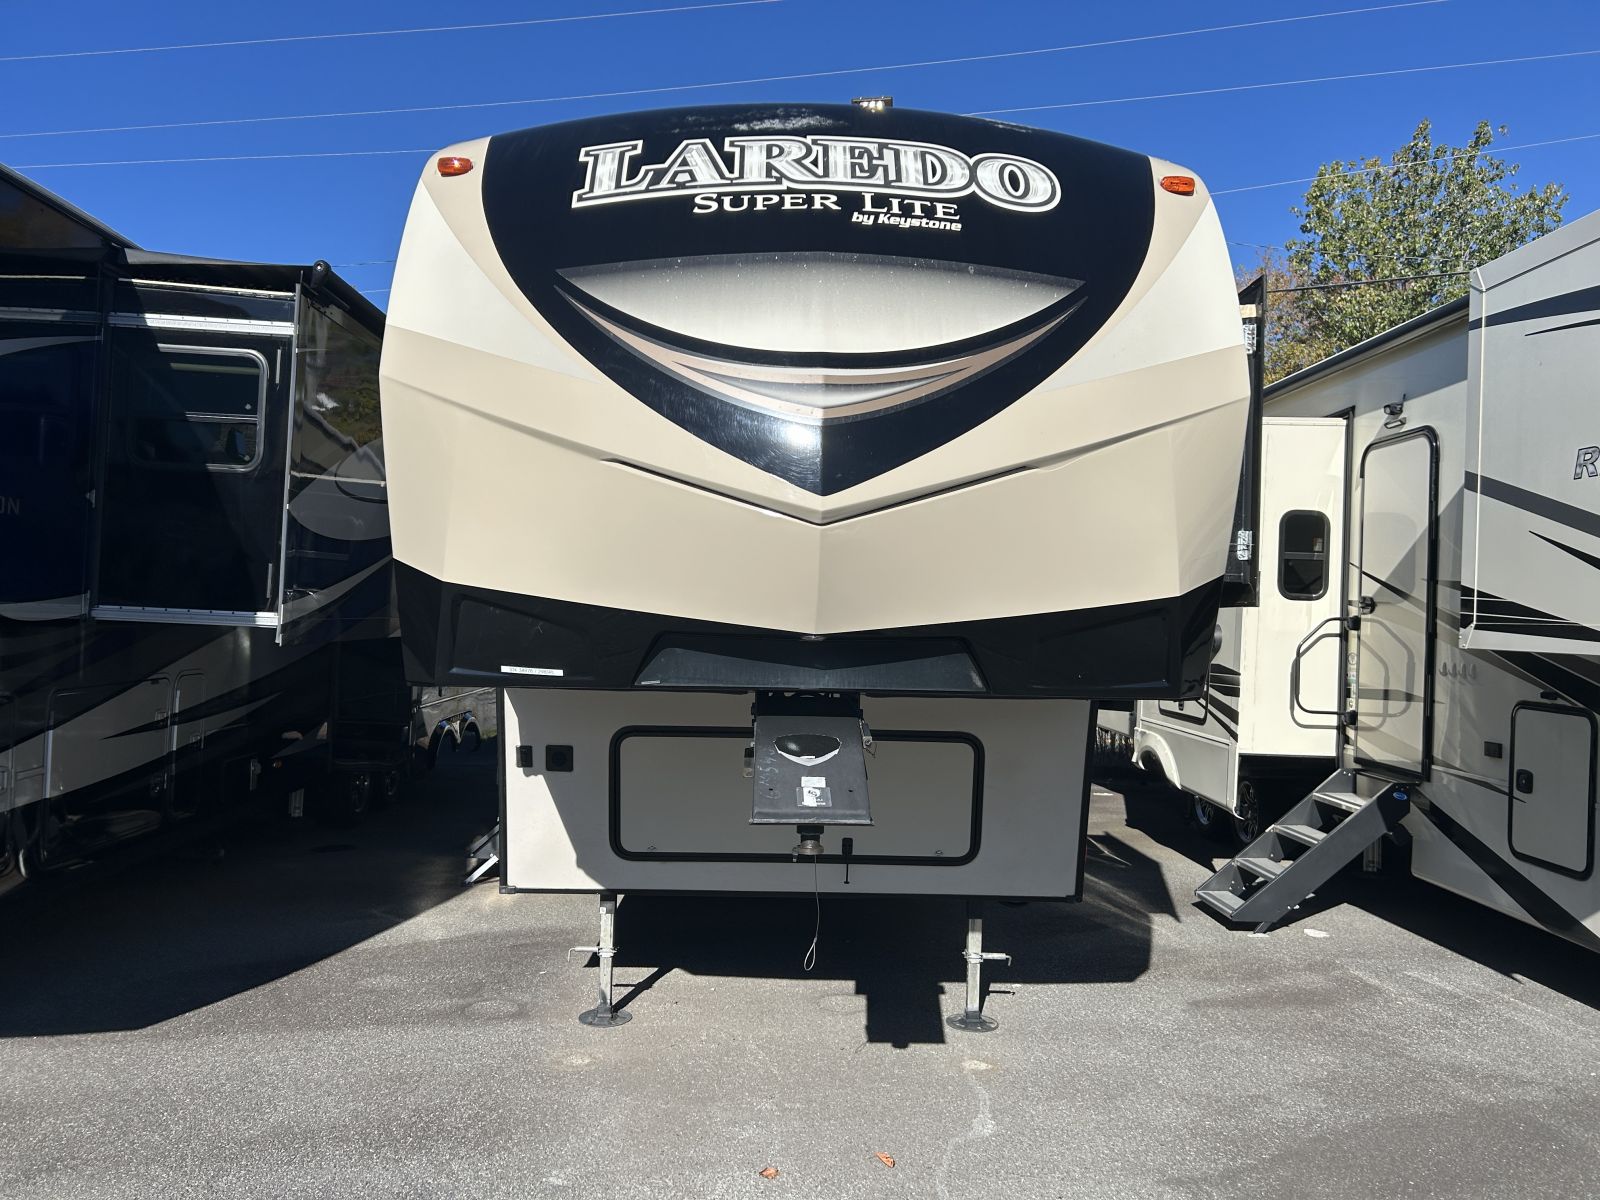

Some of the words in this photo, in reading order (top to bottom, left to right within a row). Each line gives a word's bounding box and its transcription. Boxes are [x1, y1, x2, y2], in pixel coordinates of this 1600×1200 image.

[572, 136, 1062, 213] LAREDO
[692, 193, 841, 214] SUPER
[861, 192, 961, 220] LITE
[851, 211, 875, 226] by
[877, 213, 962, 232] Keystone
